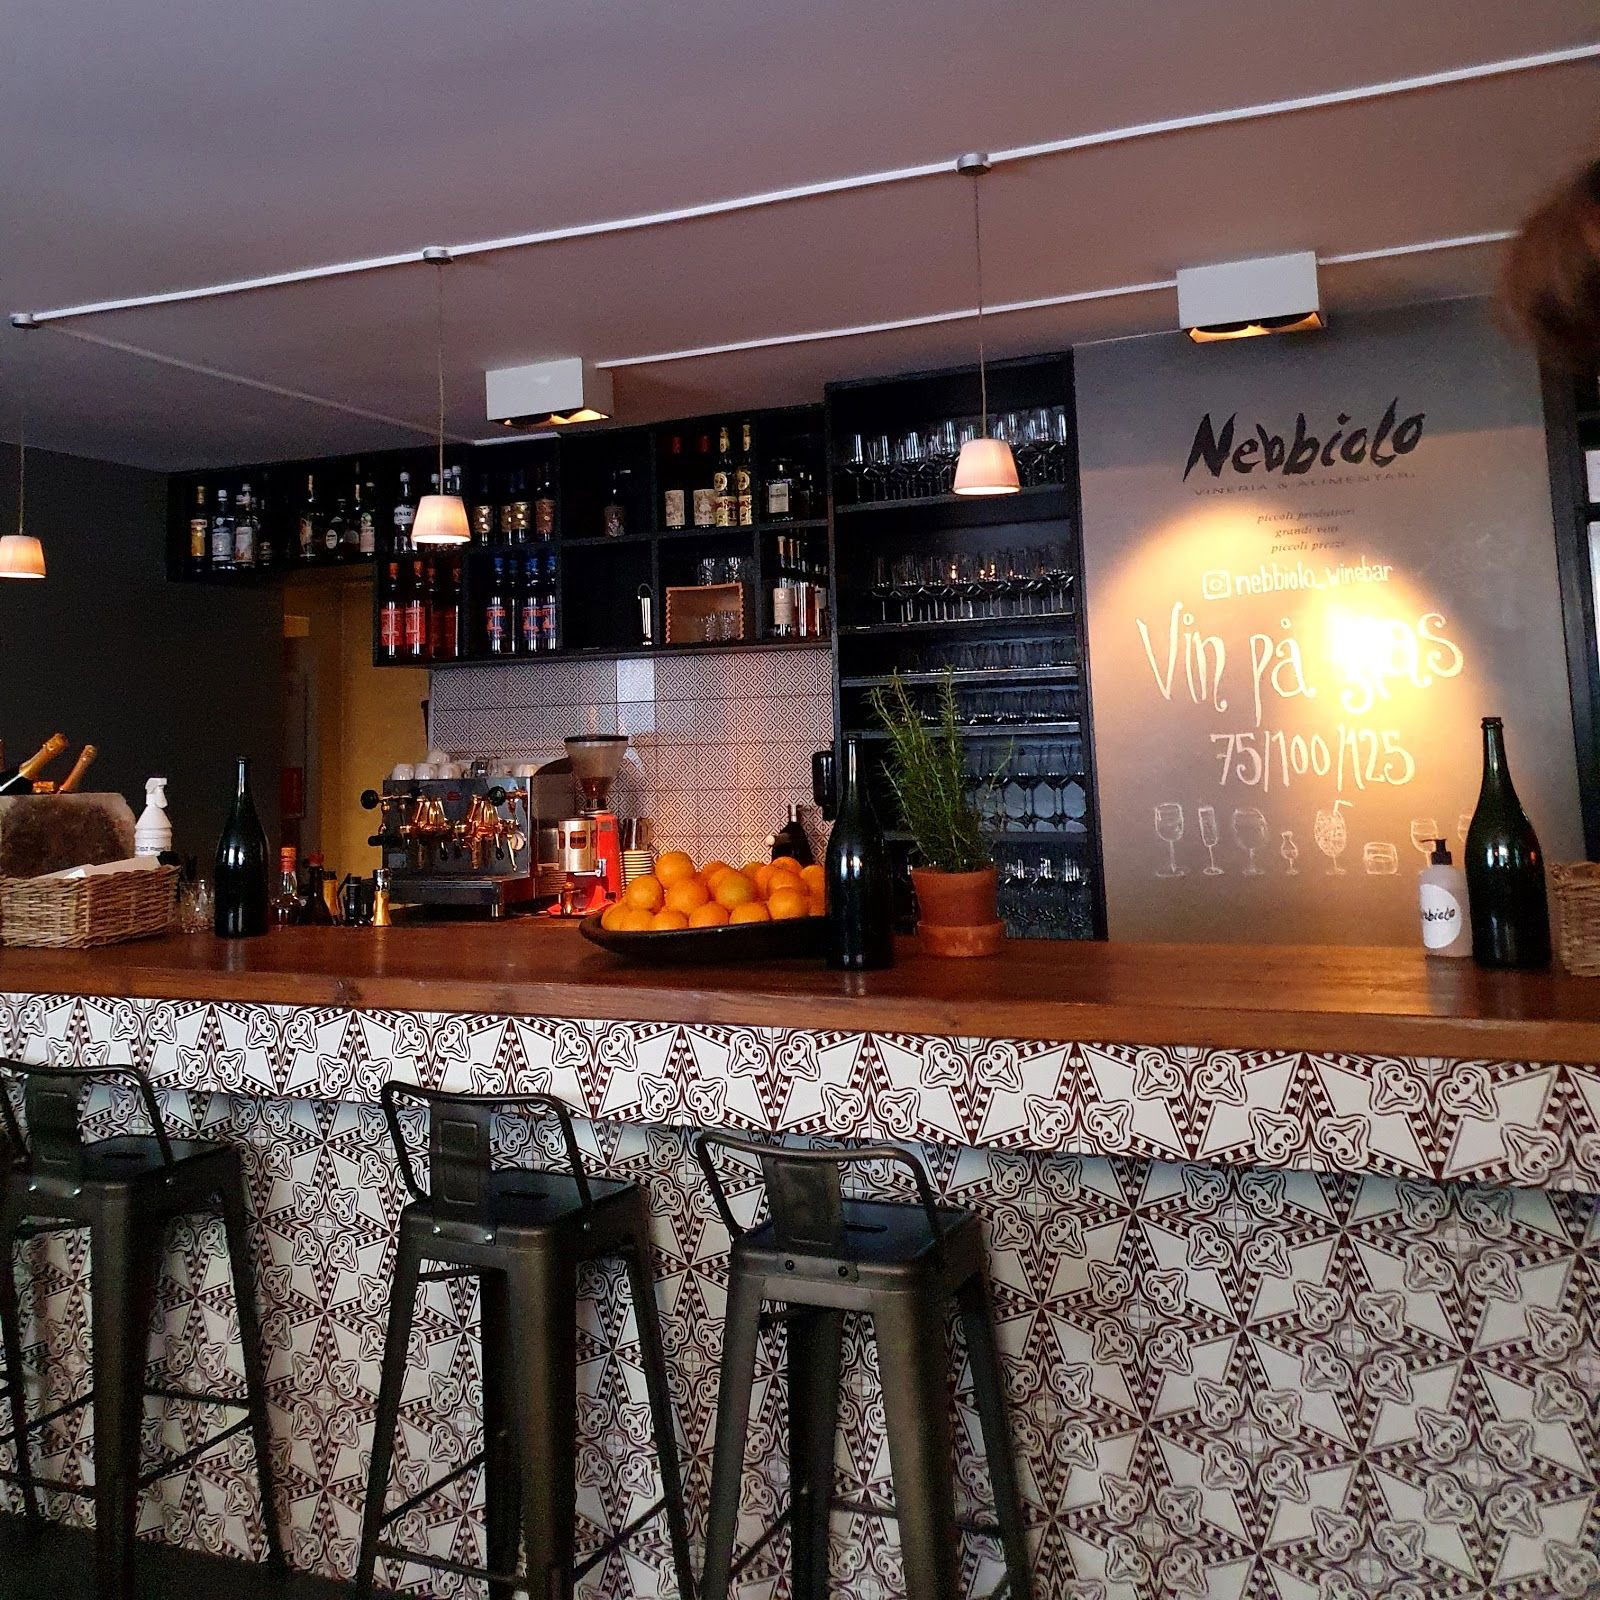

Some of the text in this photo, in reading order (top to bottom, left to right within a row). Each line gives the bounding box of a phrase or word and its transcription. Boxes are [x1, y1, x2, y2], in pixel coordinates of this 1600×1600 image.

[1183, 397, 1426, 482] Nebbiolo
[1257, 511, 1294, 524] piccoli
[1274, 526, 1312, 538] grandi
[1270, 541, 1308, 554] piccoli
[1135, 601, 1228, 713] Vin
[1249, 617, 1317, 728] på
